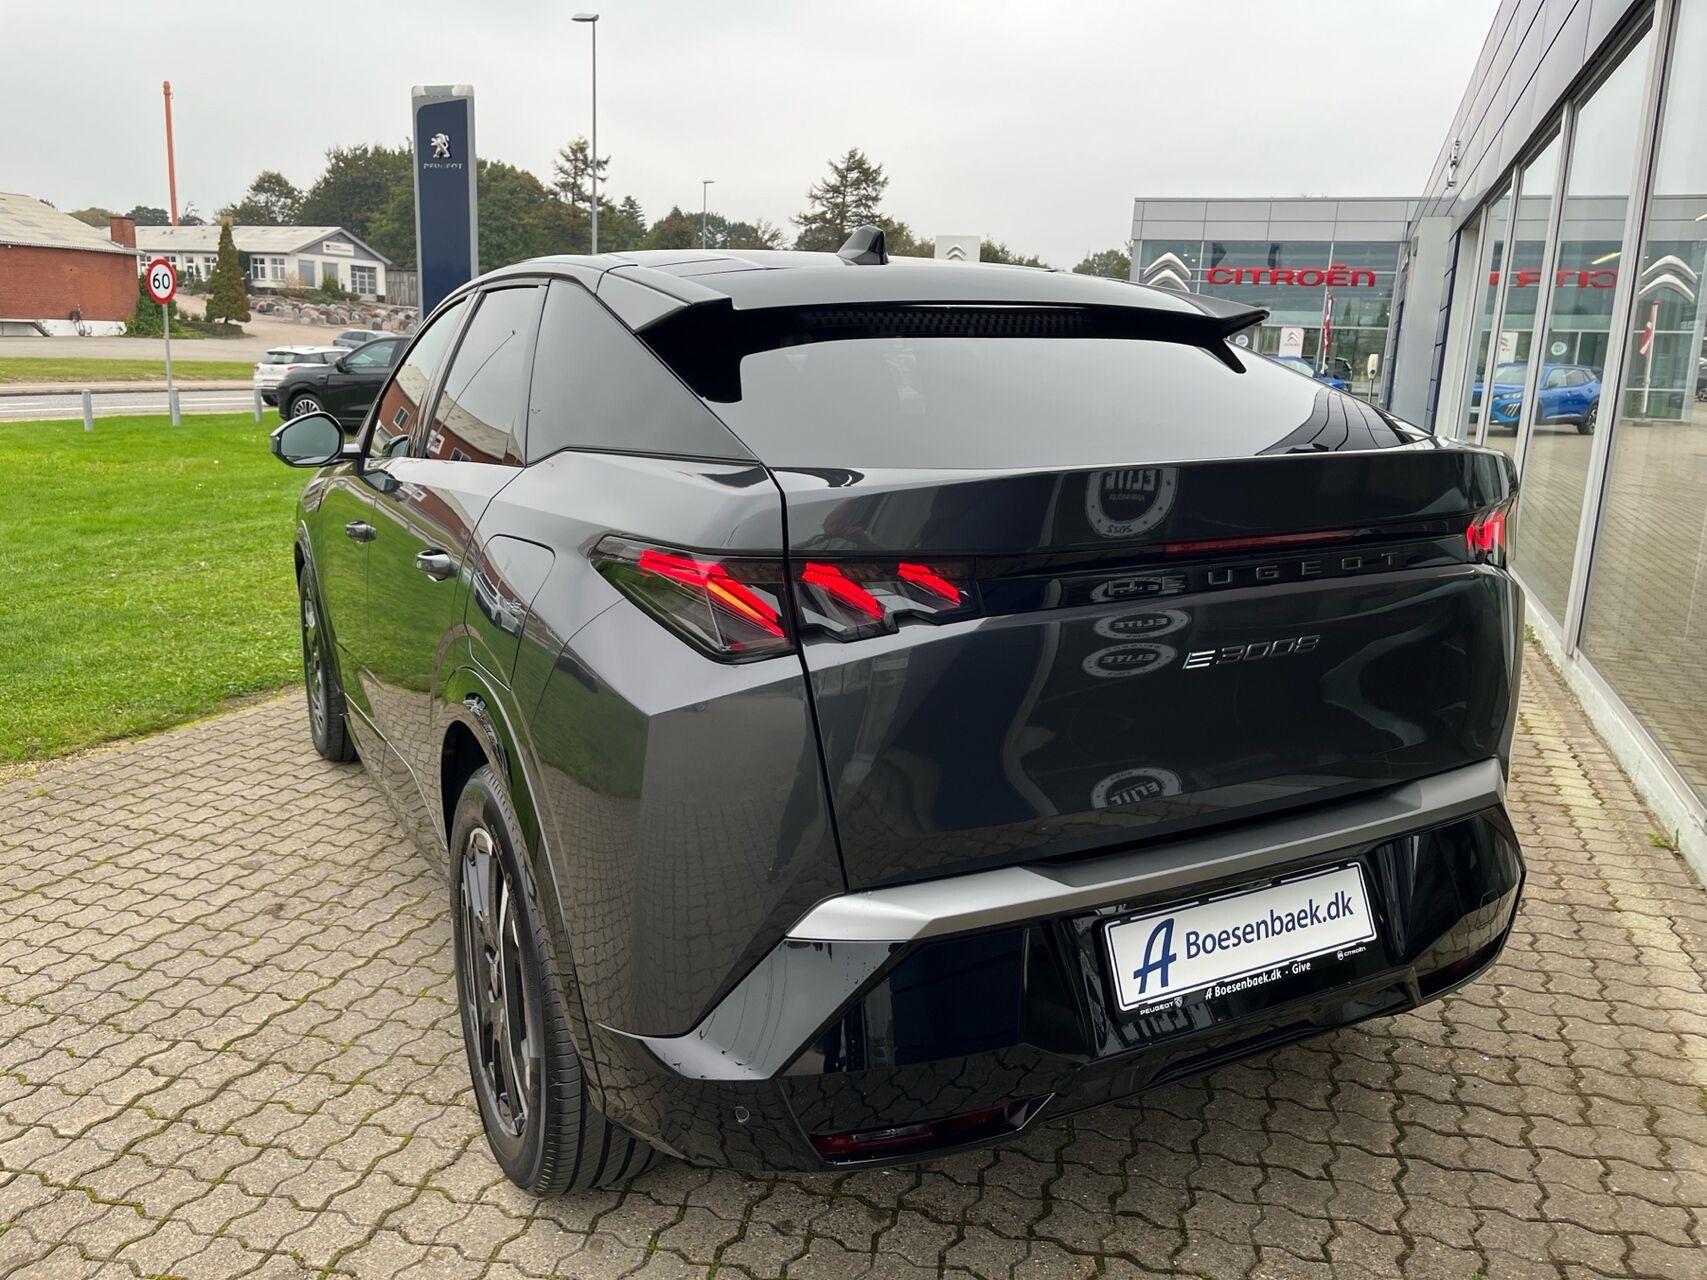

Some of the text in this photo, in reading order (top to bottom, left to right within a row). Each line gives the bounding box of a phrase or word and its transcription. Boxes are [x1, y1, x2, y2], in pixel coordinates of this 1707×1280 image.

[152, 273, 170, 289] 60
[1185, 891, 1354, 959] Boesenbaek.dk
[1215, 969, 1282, 997] Boesenbaek.dk
[1292, 961, 1311, 975] Give
[1140, 1001, 1174, 1015] PEUGEOT
